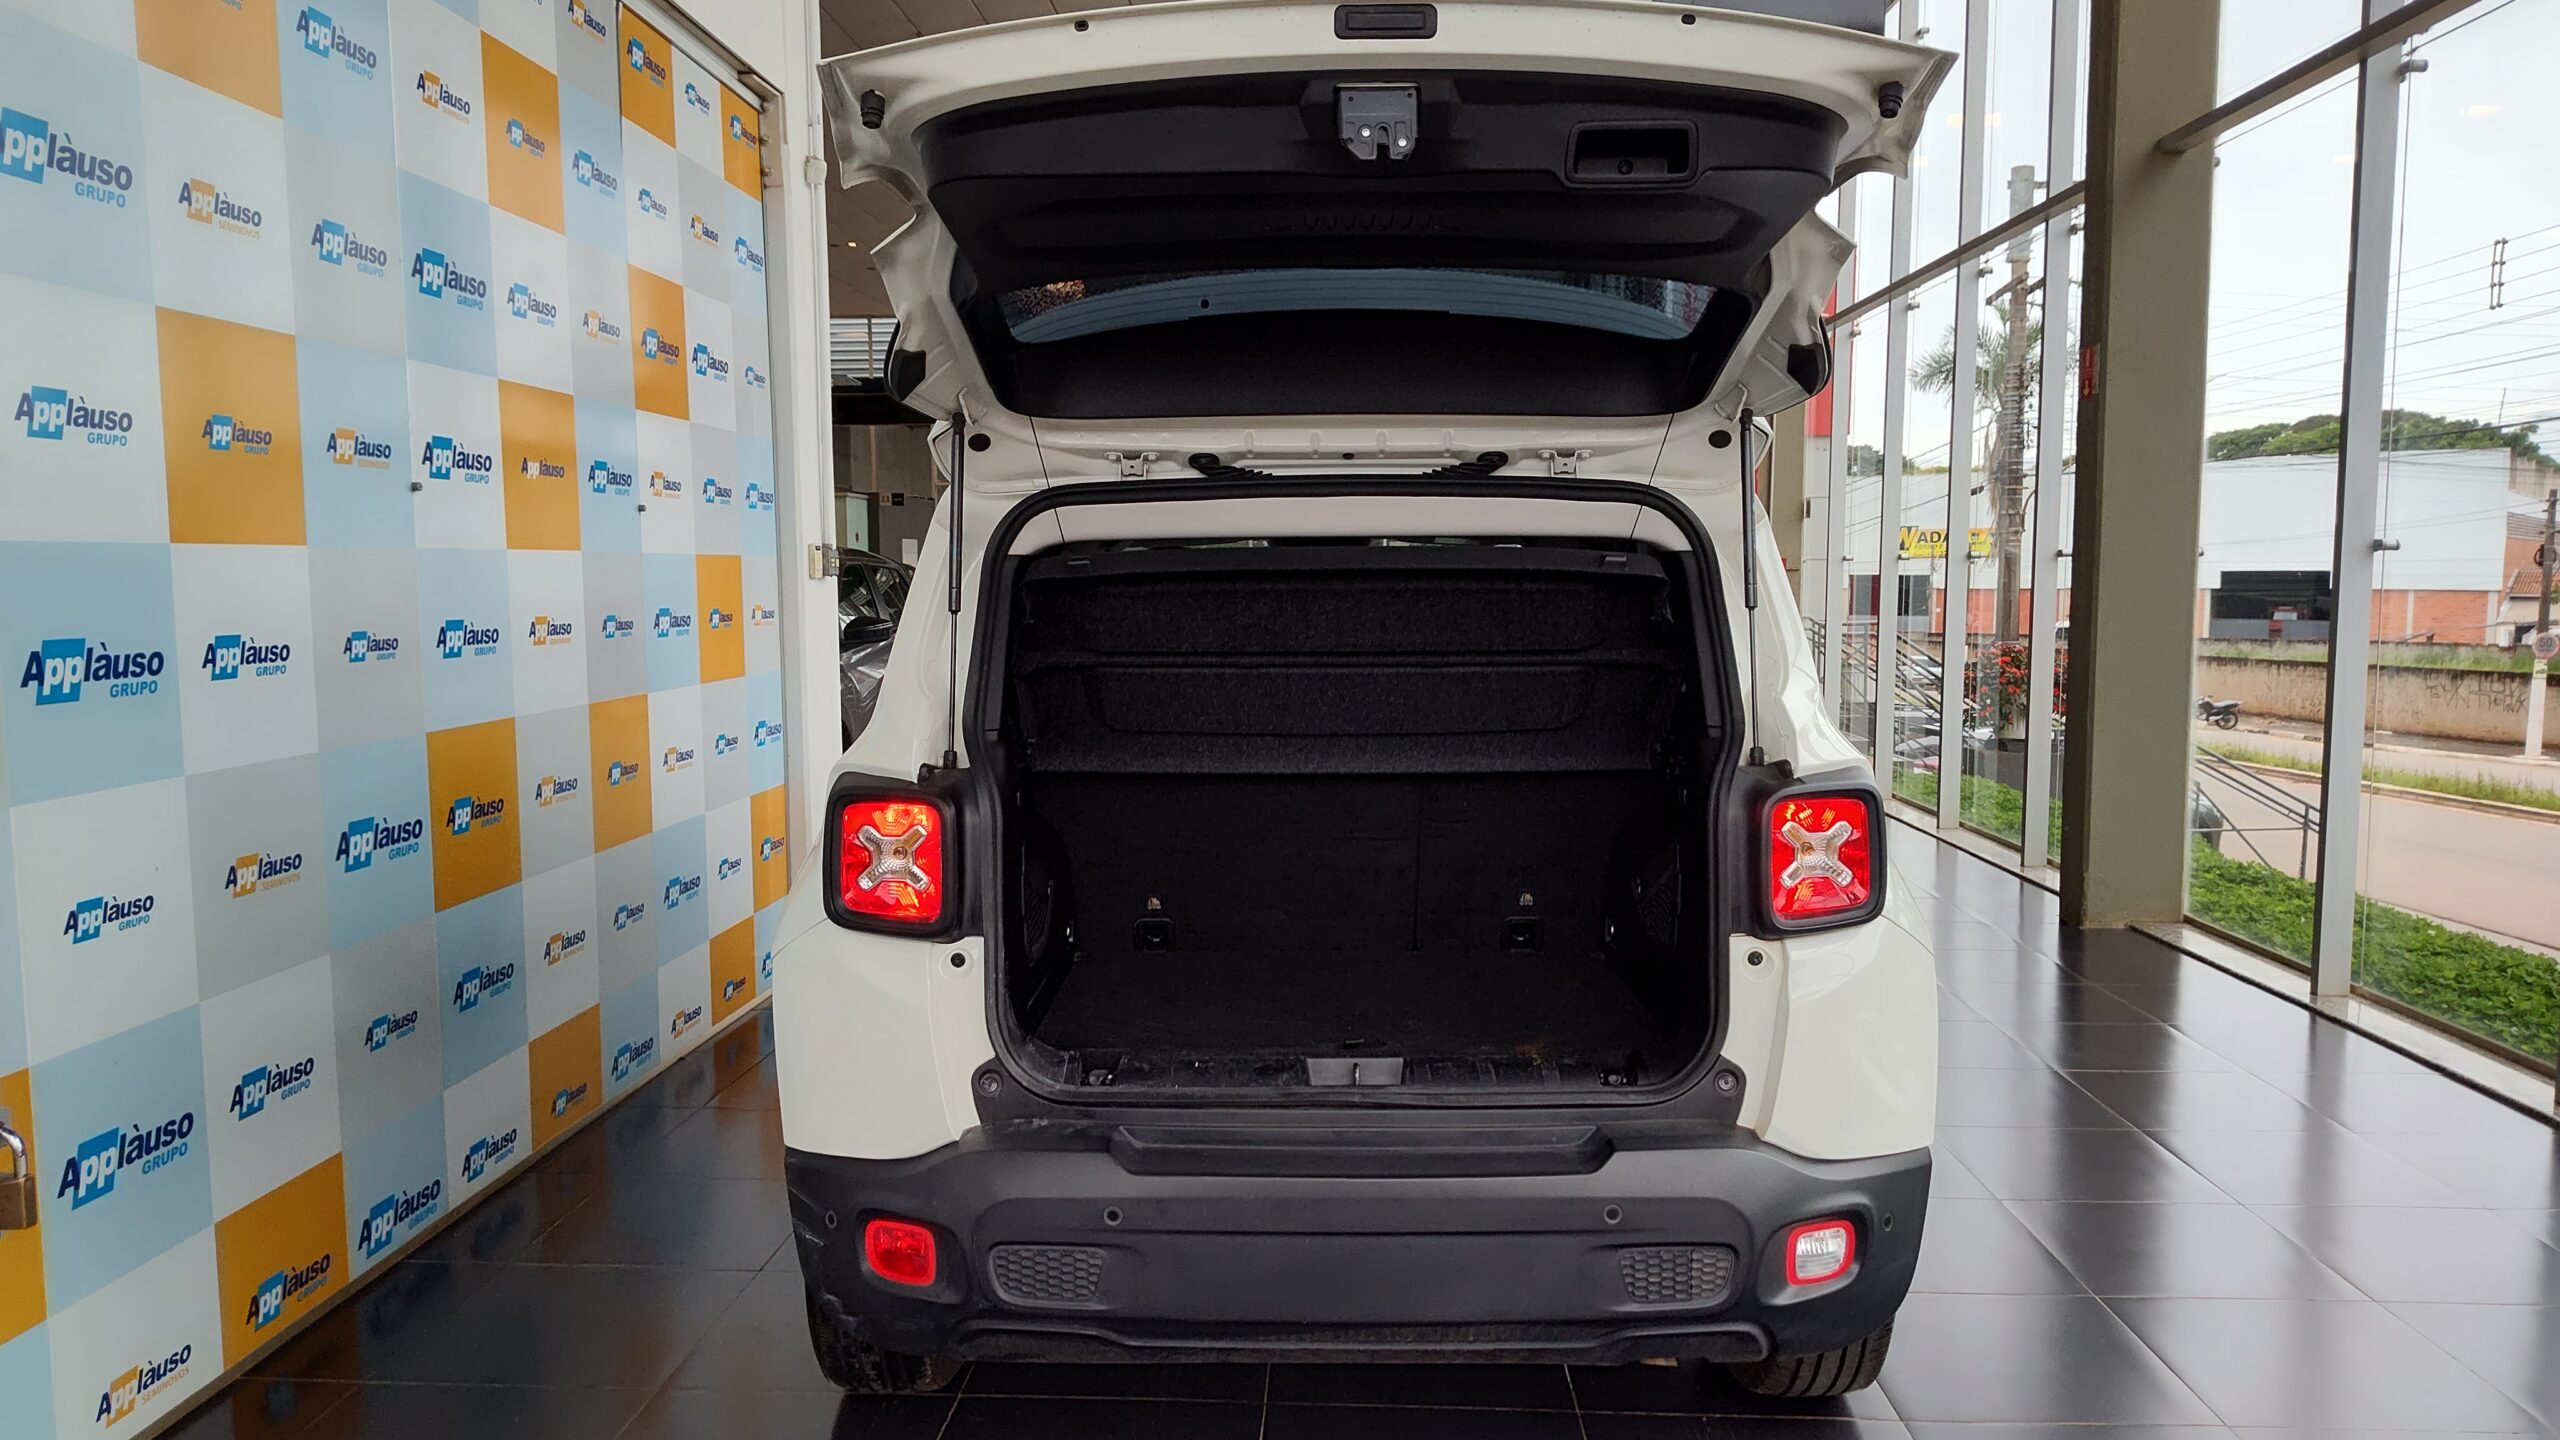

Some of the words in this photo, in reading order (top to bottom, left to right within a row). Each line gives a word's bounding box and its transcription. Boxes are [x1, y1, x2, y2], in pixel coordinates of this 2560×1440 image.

[296, 9, 377, 69] Applàuso
[345, 60, 374, 80] GRUPO
[416, 73, 471, 115] Applàuso
[0, 123, 133, 191] pplàuso
[74, 182, 126, 208] GRUPO
[178, 181, 262, 228] Applàuso
[311, 223, 388, 267] Applàuso
[357, 261, 385, 278] GRUPO
[411, 253, 487, 298] Applàuso
[457, 295, 483, 310] GRUPO
[507, 287, 557, 318] Applàuso
[14, 391, 133, 433] Applàuso
[87, 431, 128, 447] GRUPO
[202, 418, 272, 446] Applàuso
[326, 432, 392, 459] Applàuso
[422, 442, 492, 472] Applàuso
[521, 457, 565, 479] Applàuso
[465, 473, 489, 484] GRUPO
[588, 465, 633, 487] Applàuso
[343, 632, 399, 657] Applàuso
[436, 622, 499, 653] Applàuso
[529, 618, 572, 641] Applàuso
[202, 637, 291, 676] Applàuso
[475, 647, 496, 656] GRUPO
[20, 642, 164, 695] Applàuso
[256, 665, 287, 678] GRUPO
[110, 680, 158, 699] GRUPO
[535, 776, 578, 803] Applàuso
[446, 797, 504, 830] Applàuso
[335, 818, 423, 865] Applàuso
[388, 842, 419, 861] GRUPO
[225, 851, 302, 893] Applàuso
[63, 895, 154, 937] Applàuso
[118, 914, 151, 931] GRUPO
[453, 963, 514, 1006] Applàuso
[364, 1010, 418, 1047] Applàuso
[229, 1056, 315, 1113] Applàuso
[281, 1079, 311, 1100] GRUPO
[57, 1111, 194, 1199] Applàuso
[142, 1142, 188, 1175] GRUPO
[461, 1128, 517, 1177] Applàuso
[357, 1178, 441, 1250] Applàuso
[408, 1203, 437, 1230] GRUPO
[245, 1253, 331, 1325] Applàuso
[96, 1343, 192, 1423] Applàuso
[141, 1365, 191, 1404] SEMINOVOS
